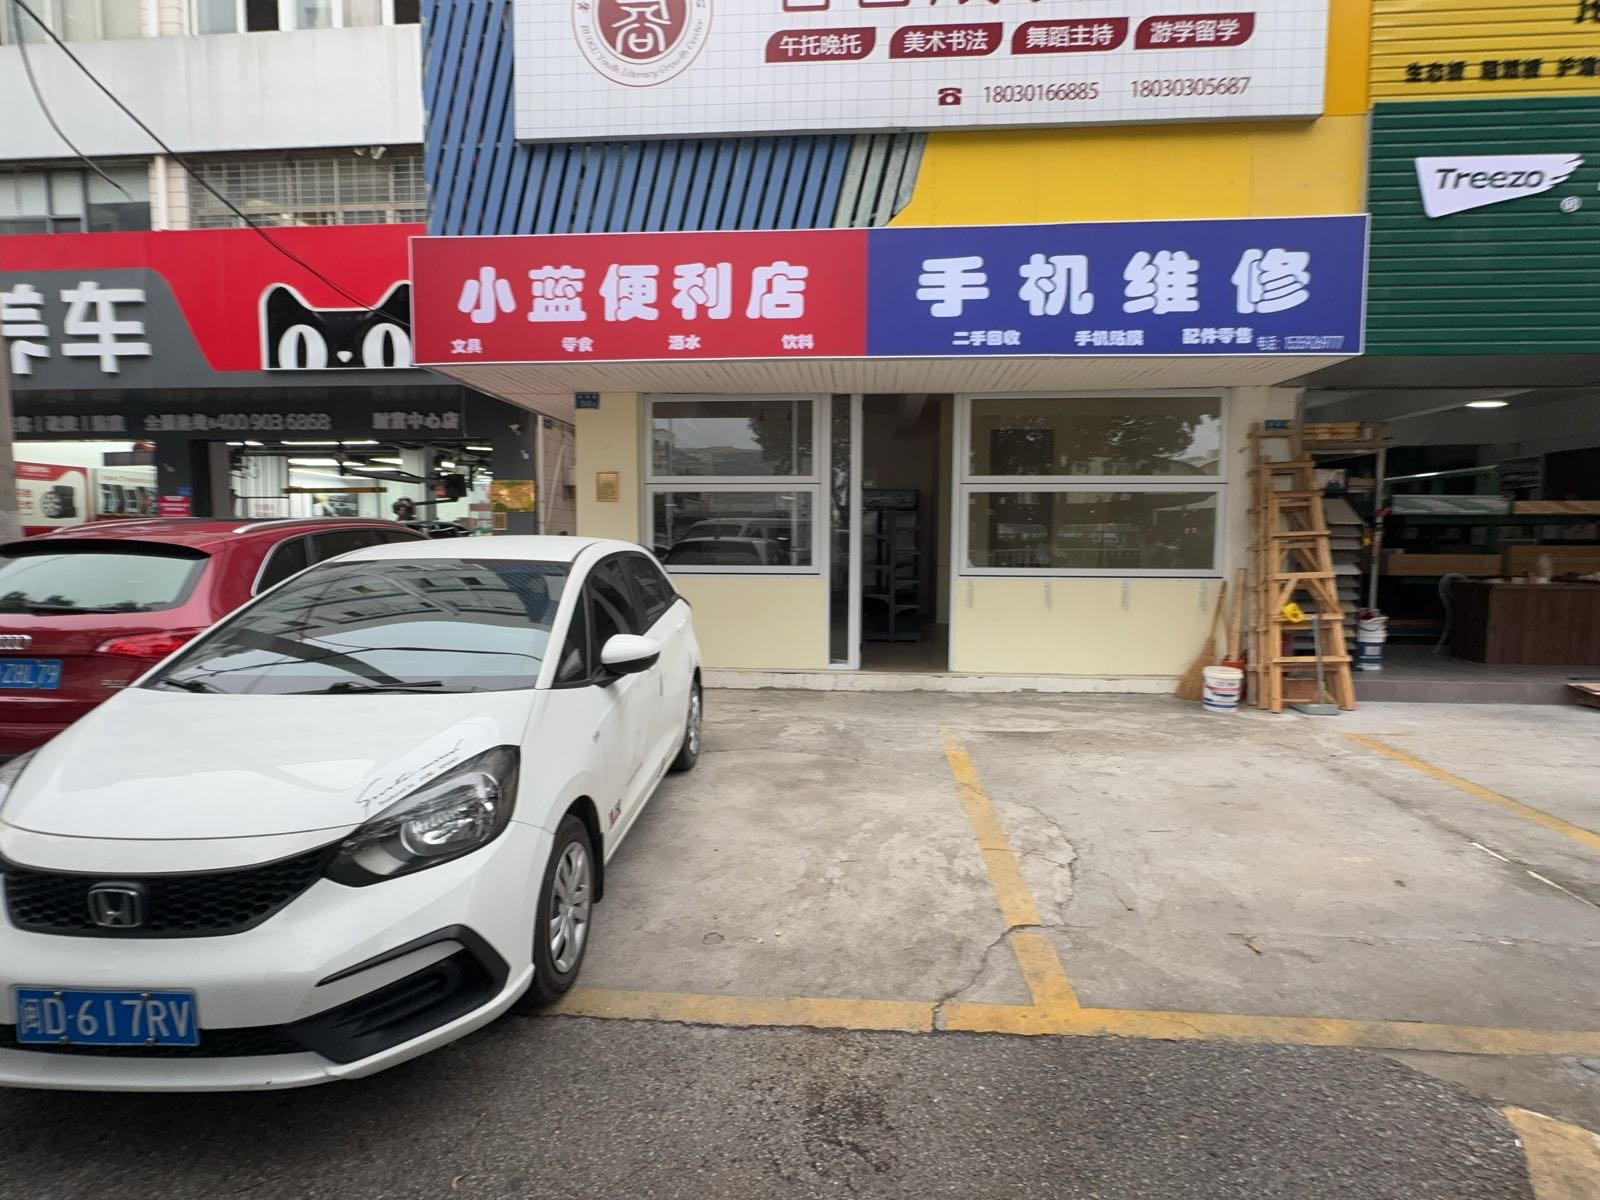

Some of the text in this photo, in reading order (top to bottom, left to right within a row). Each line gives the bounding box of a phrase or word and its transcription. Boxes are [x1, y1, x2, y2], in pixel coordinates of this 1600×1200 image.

[779, 18, 1240, 57] 午托晚托 美术书法 舞蹈主持 游学留学
[983, 76, 1251, 103] 18030166885 18030305687
[1435, 168, 1545, 190] Treezo
[457, 261, 809, 324] 小蓝便利店
[915, 247, 1312, 319] 手机维修
[450, 333, 815, 354] 文具 零食 酒水 饮料
[952, 329, 1021, 347] 二手回收
[1074, 329, 1145, 347] 手机贴膜
[1182, 327, 1254, 345] 配件零售
